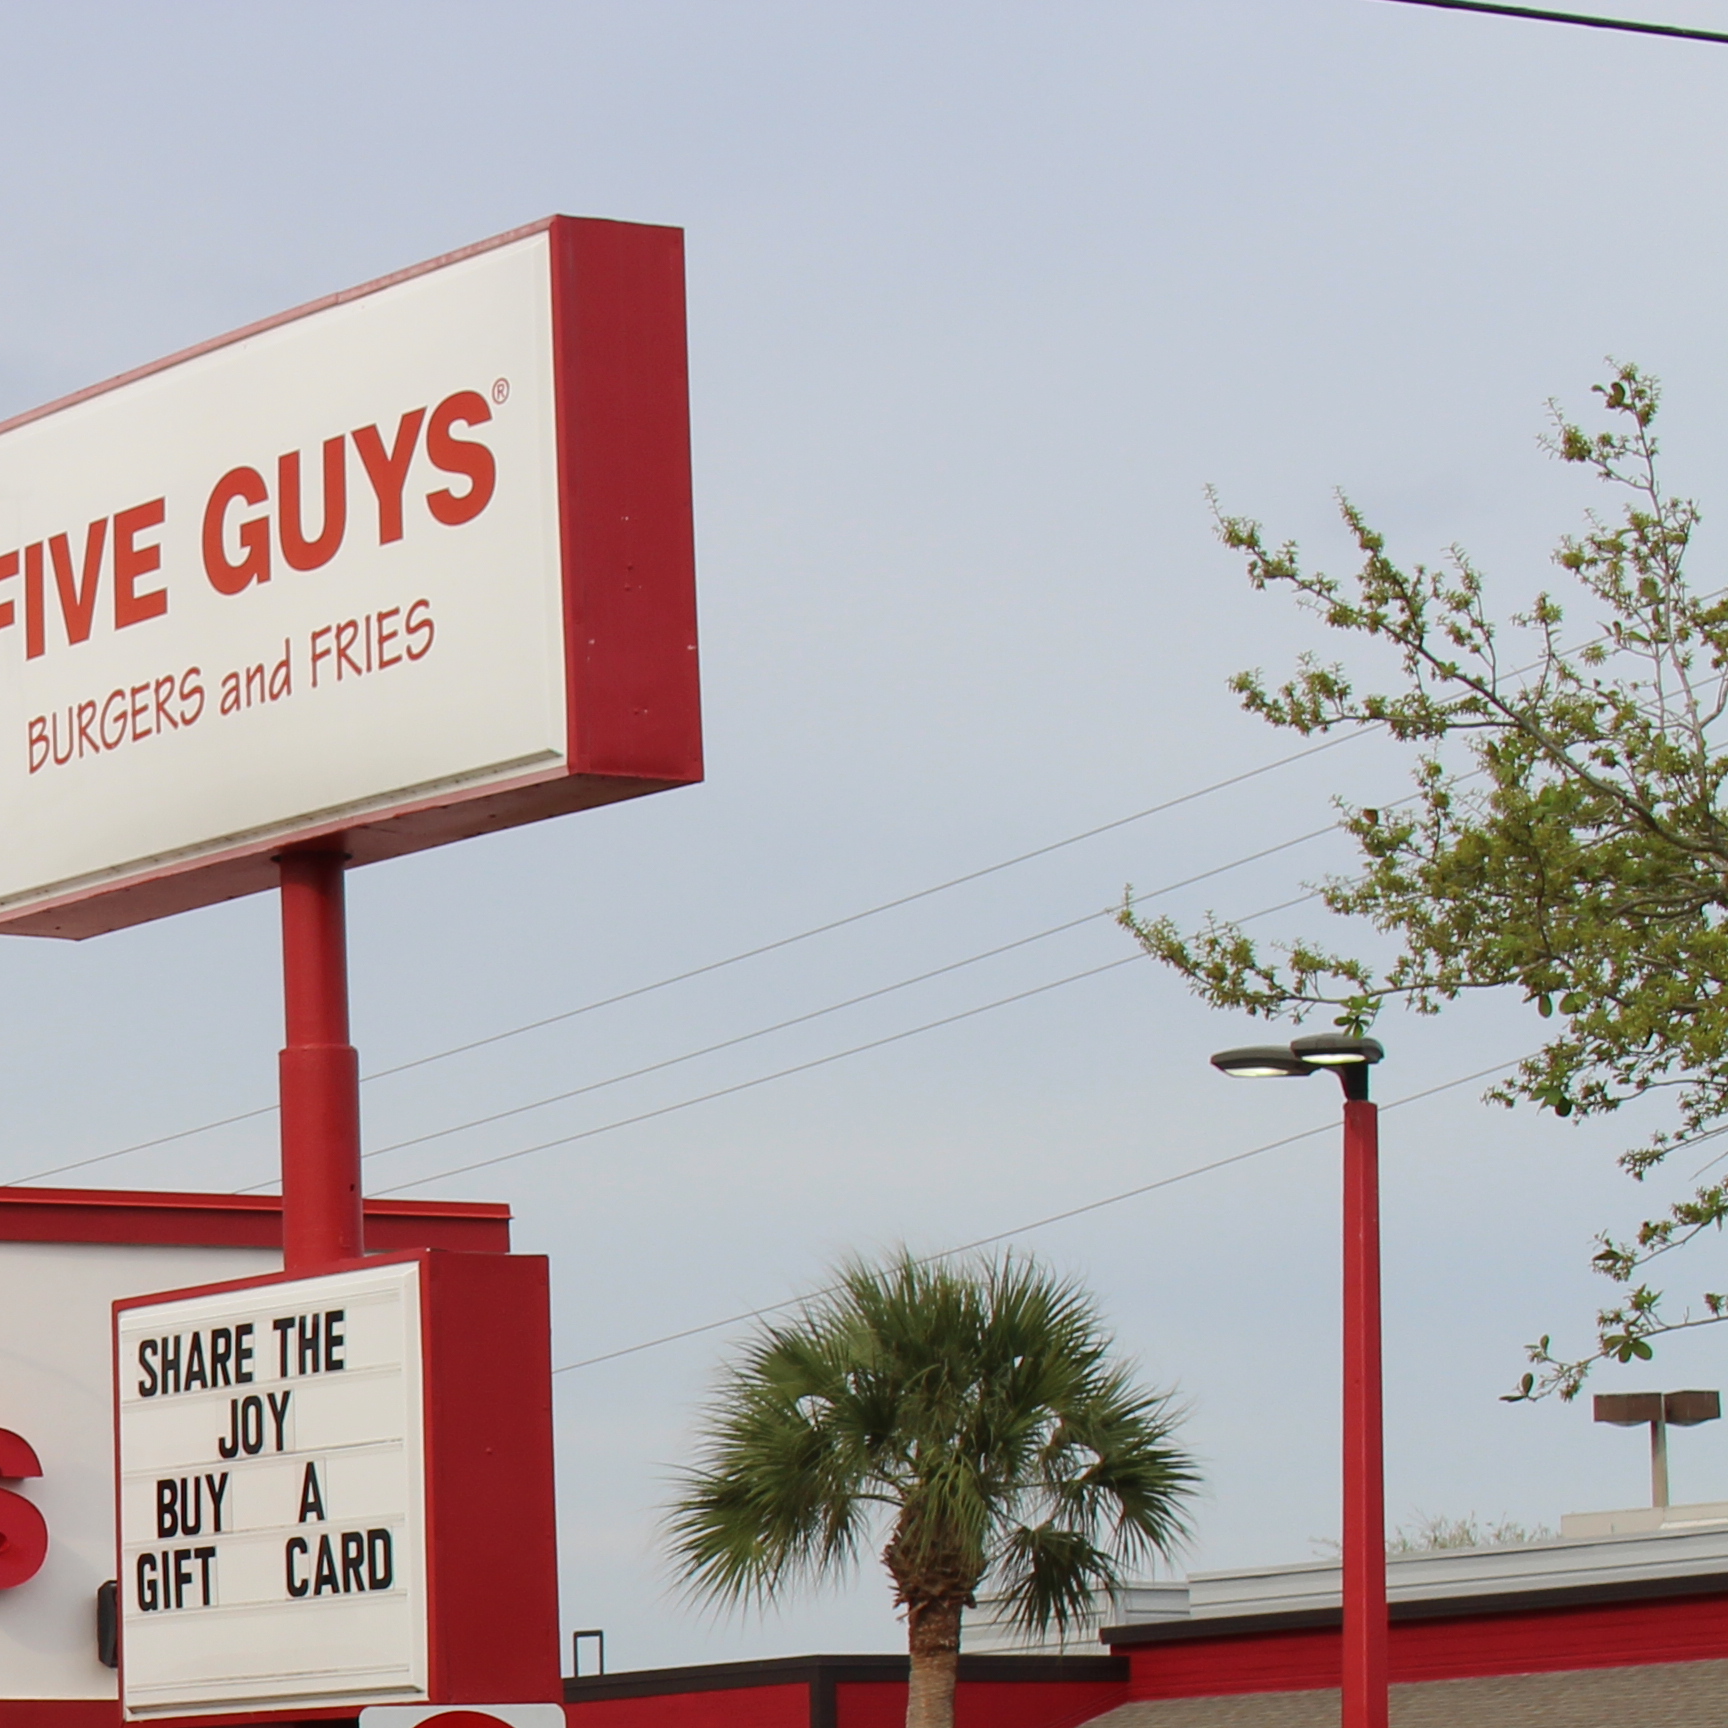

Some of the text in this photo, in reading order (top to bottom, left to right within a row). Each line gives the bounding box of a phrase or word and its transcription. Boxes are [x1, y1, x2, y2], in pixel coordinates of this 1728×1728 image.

[27, 598, 436, 775] BURGERS and FRIES
[138, 1309, 345, 1398] SHARE THE
[218, 1389, 291, 1460] JOY
[156, 1461, 325, 1539] BUY A
[136, 1528, 393, 1612] GIFT CARD
